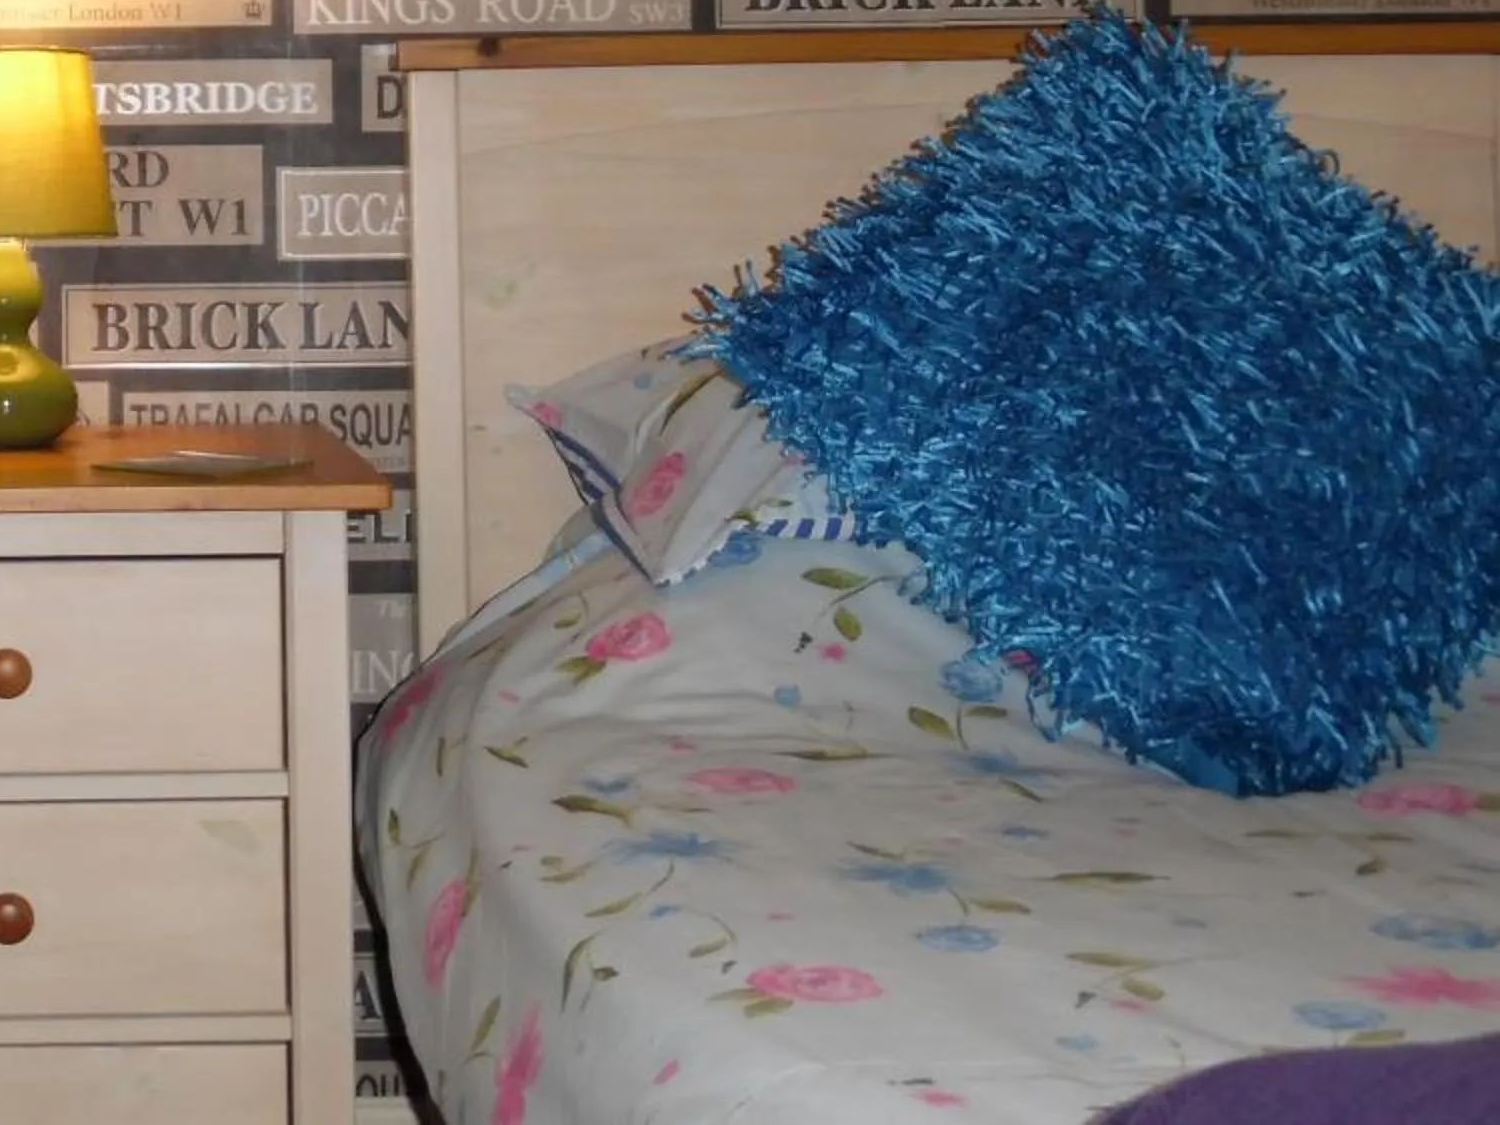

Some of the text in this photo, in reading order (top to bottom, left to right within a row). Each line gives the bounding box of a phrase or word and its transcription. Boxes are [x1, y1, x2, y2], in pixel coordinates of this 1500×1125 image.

[69, 1, 142, 22] London
[629, 1, 684, 25] SW3
[179, 198, 249, 236] W1
[92, 301, 288, 352] BRICK
